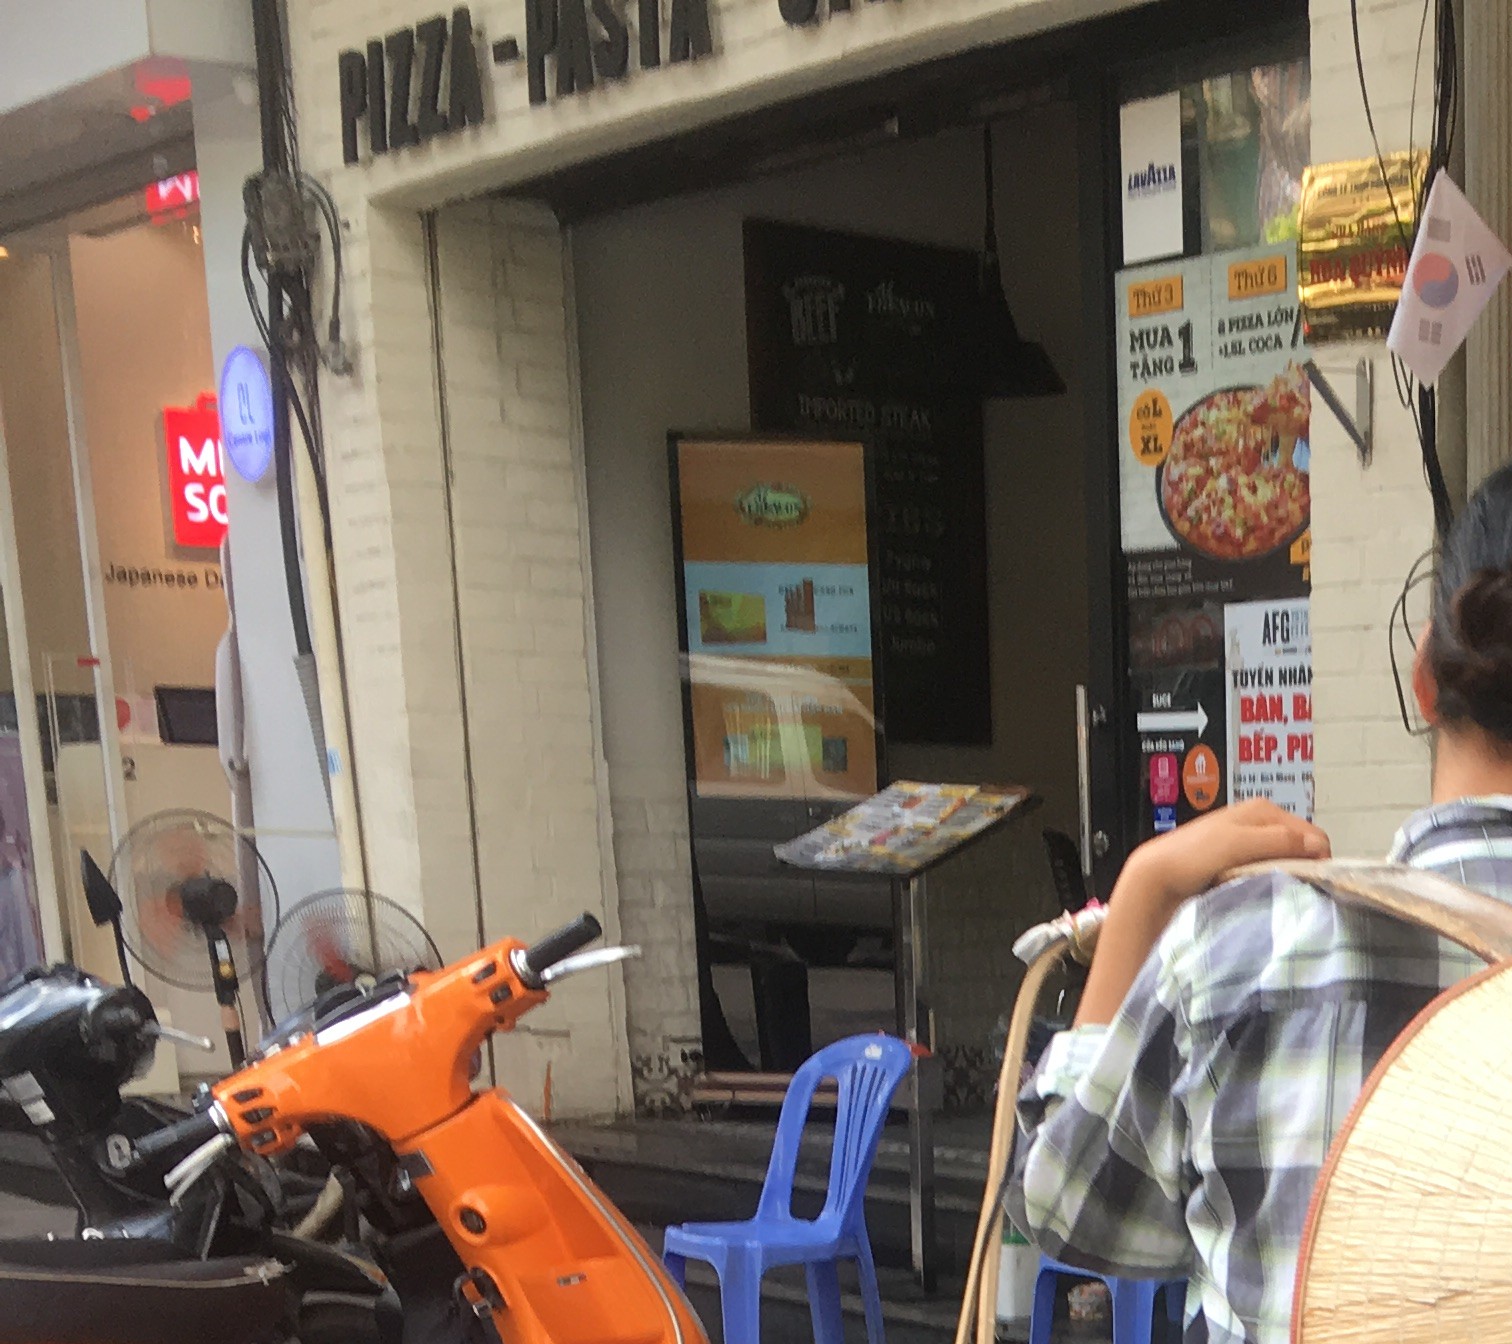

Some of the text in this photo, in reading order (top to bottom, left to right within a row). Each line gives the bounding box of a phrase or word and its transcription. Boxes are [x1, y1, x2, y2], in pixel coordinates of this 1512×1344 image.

[338, 4, 484, 166] PIZZA
[1129, 319, 1198, 378] MUA 1
[105, 563, 198, 589] Japanese
[1262, 609, 1290, 647] AFG
